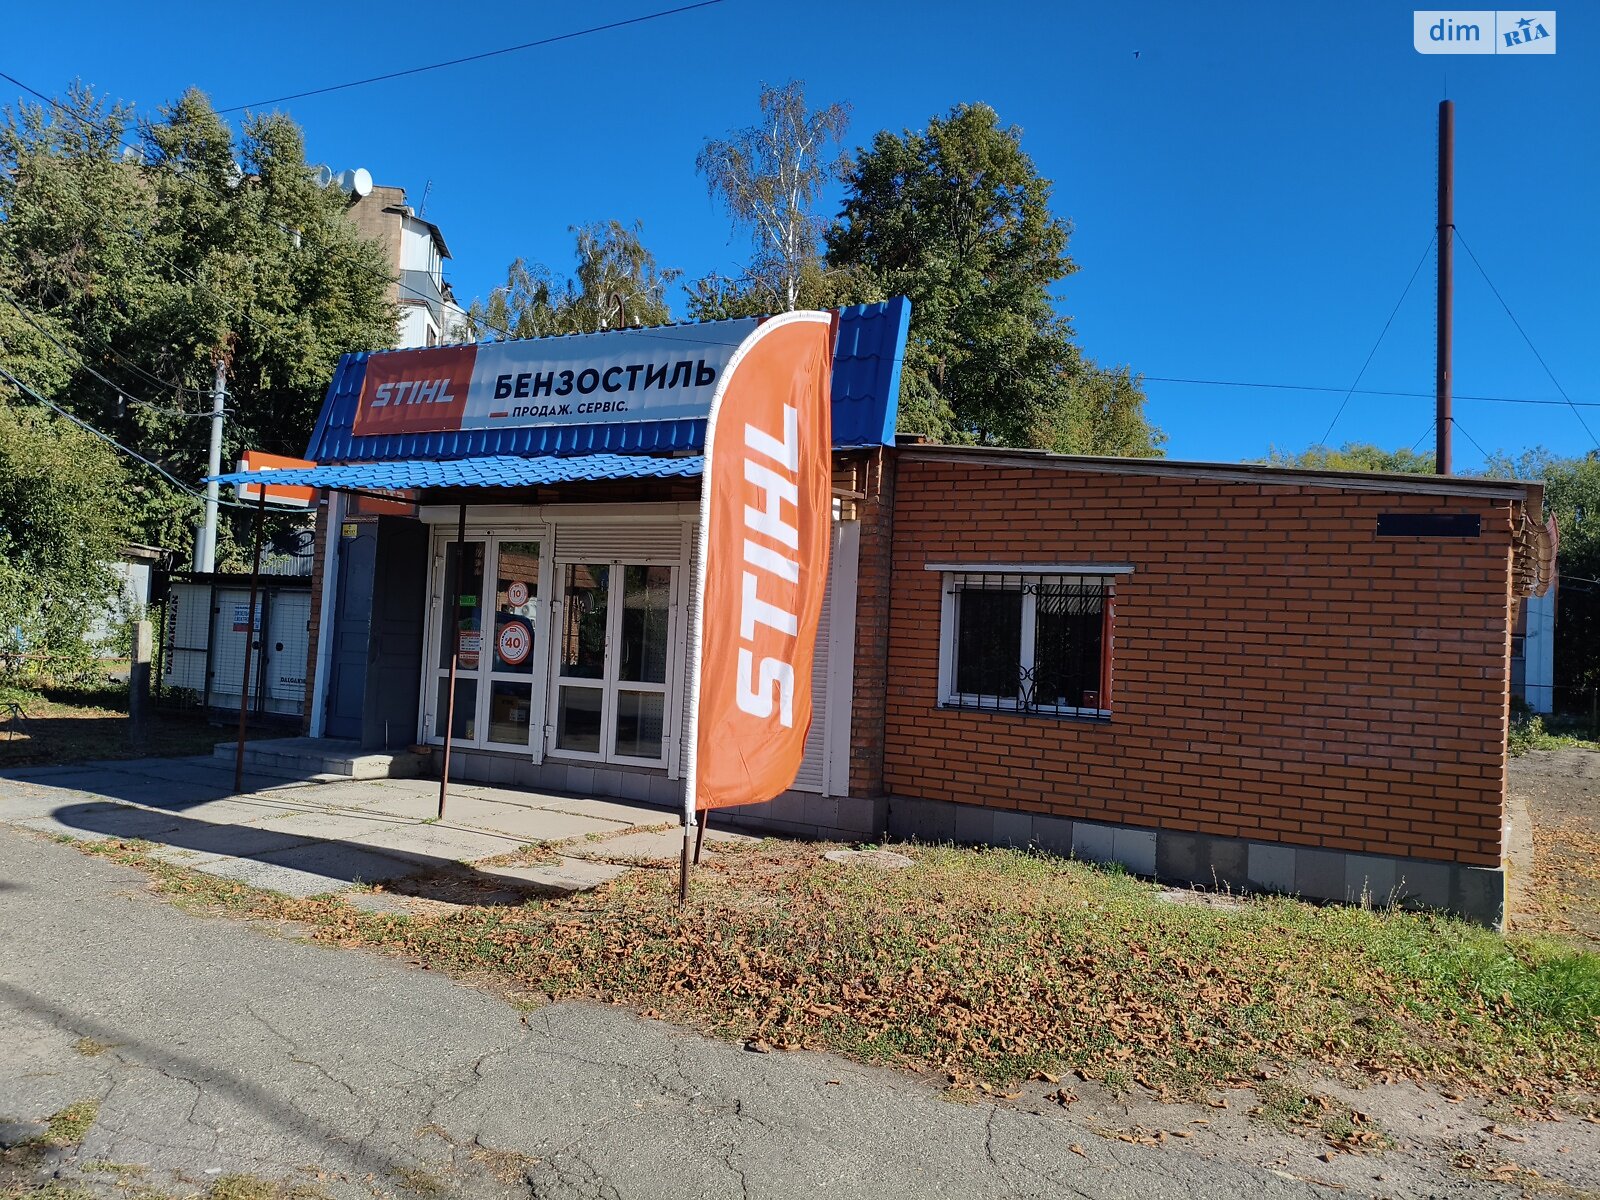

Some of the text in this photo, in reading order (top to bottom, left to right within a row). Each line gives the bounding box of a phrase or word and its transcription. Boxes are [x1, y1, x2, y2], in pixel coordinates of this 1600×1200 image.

[371, 379, 454, 407] STIHL
[494, 360, 716, 399] БЕНЗОСТИЛЬ
[512, 401, 629, 418] ПРОДАЖ. СЕРВІС.
[736, 403, 799, 728] STIHL
[505, 638, 521, 648] 40
